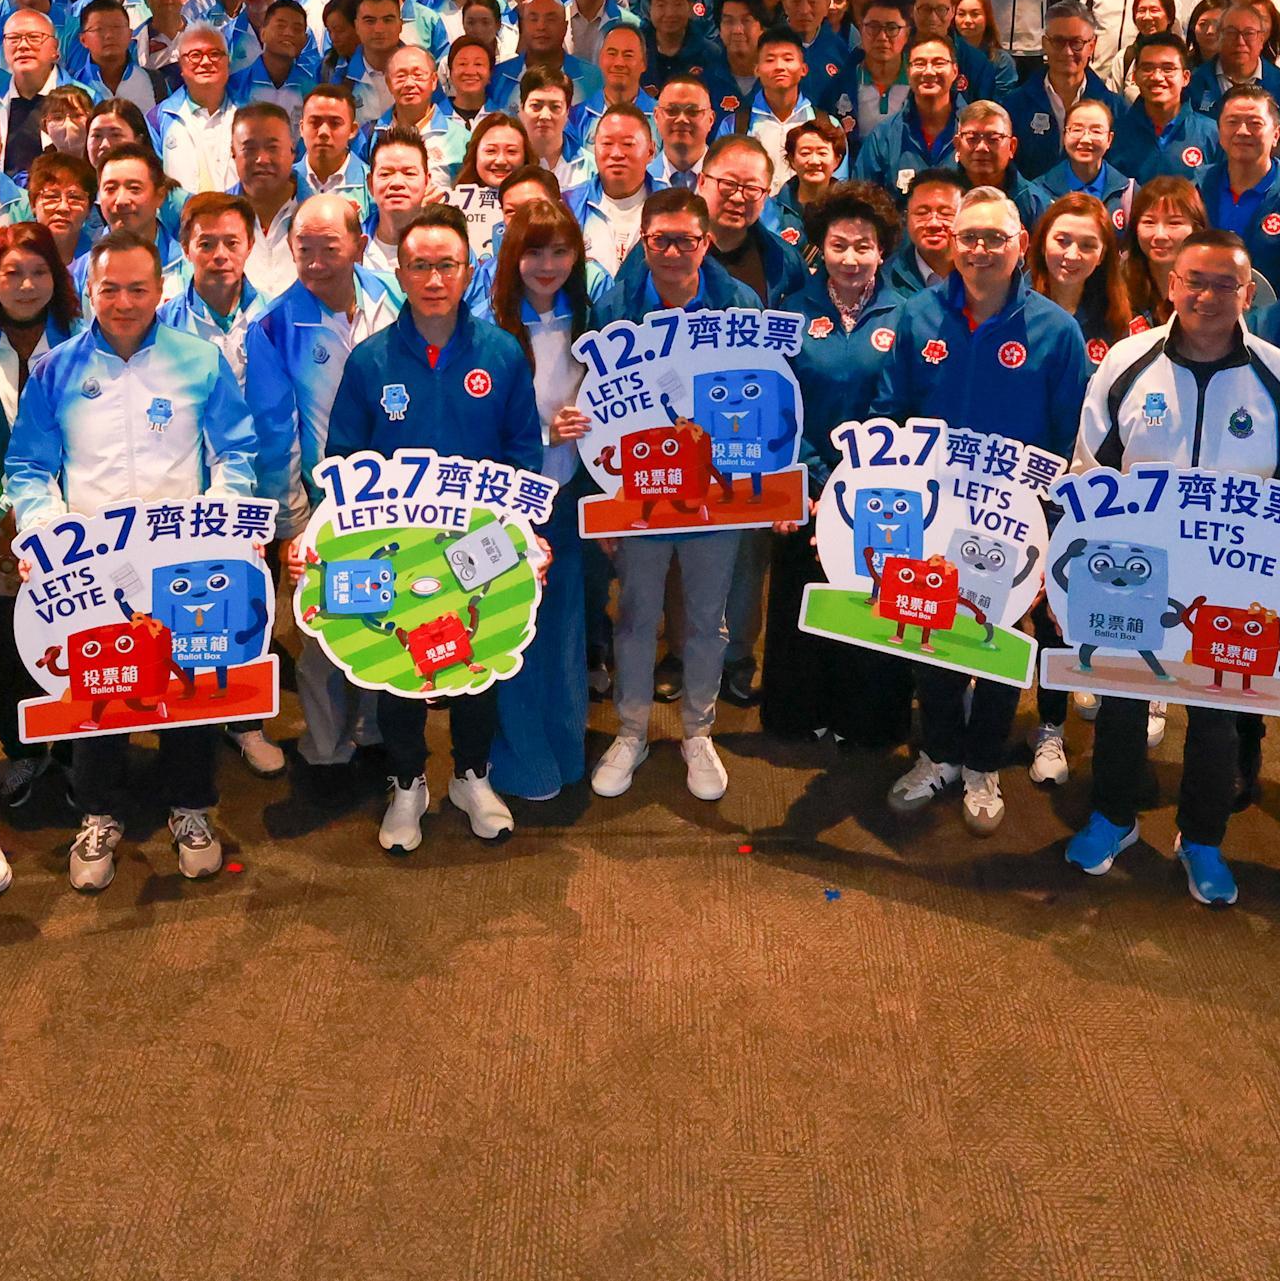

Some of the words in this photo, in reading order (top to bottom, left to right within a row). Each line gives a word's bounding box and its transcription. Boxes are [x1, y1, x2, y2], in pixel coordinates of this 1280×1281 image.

[466, 213, 486, 223] OTE
[578, 316, 680, 377] 12.7
[687, 315, 799, 352] 齊投票
[586, 373, 644, 407] LET'S
[592, 390, 654, 425] VOTE
[711, 443, 762, 460] 投票箱
[837, 427, 941, 468] 12.7
[946, 433, 1063, 495] 齊投票
[716, 458, 740, 466] Ballot
[741, 458, 755, 467] Box
[320, 456, 430, 507] 12.7
[437, 462, 553, 518] 齊投票
[634, 468, 683, 488] 投票箱
[640, 485, 662, 494] Ballot
[663, 485, 677, 493] Box
[953, 479, 1012, 511] LET'S
[1057, 469, 1170, 523] 12.7
[337, 506, 399, 530] LET'S
[402, 505, 466, 528] VOTE
[969, 507, 1029, 543] VOTE
[21, 506, 137, 574] 12.7
[146, 505, 271, 541] 齊投票
[1179, 520, 1244, 545] LET'S
[1208, 546, 1277, 577] VOTE
[28, 568, 95, 605] LET'S
[34, 589, 106, 623] VOTE
[895, 594, 937, 615] 投票箱
[900, 609, 918, 619] Ballot
[919, 612, 931, 621] Box
[1089, 613, 1144, 634] 投票箱
[171, 635, 228, 655] 投票箱
[1095, 629, 1119, 641] Ballot
[1120, 631, 1136, 641] Box
[177, 651, 201, 661] Ballot
[204, 651, 221, 661] Box
[426, 640, 457, 660] 投票箱
[1209, 641, 1258, 662] 投票箱
[1215, 656, 1236, 667] Ballot
[1238, 658, 1250, 668] Box
[82, 665, 138, 687] 投票箱
[90, 684, 114, 695] Ballot
[117, 683, 132, 693] Box
